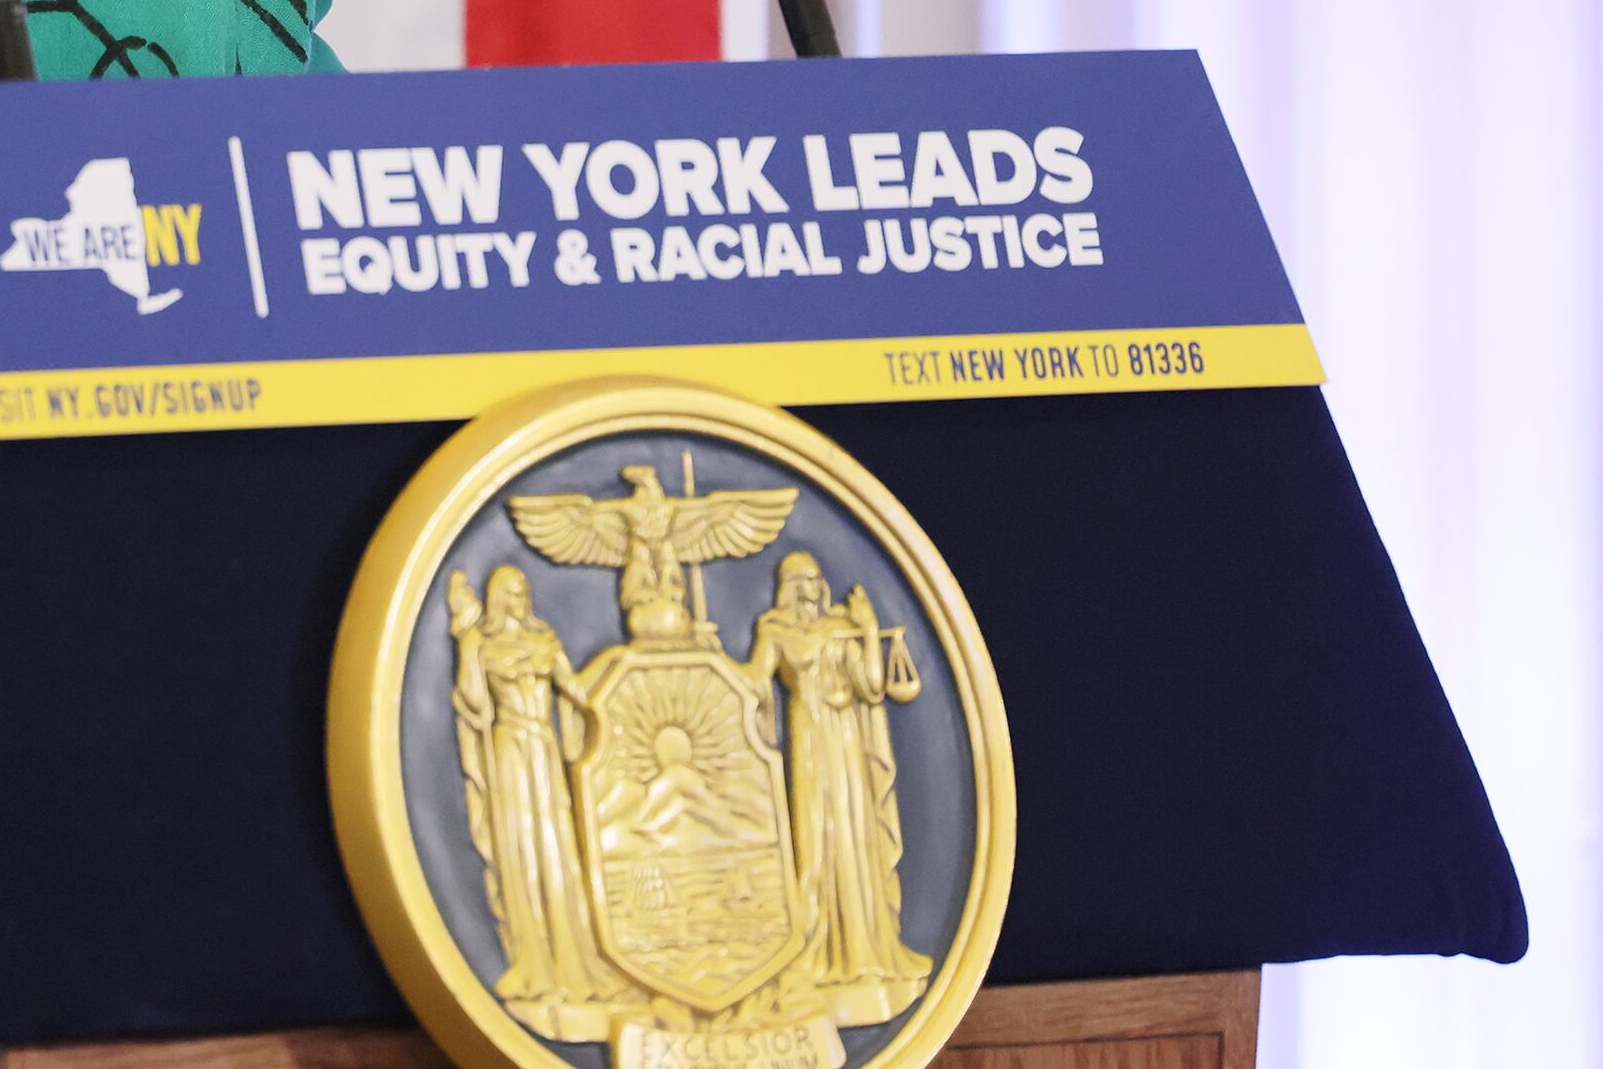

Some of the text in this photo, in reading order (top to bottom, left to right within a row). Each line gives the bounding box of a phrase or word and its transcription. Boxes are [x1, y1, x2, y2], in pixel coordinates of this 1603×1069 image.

[286, 126, 1094, 230] NEW YORK LEADS
[23, 203, 202, 267] WE ARE NY
[300, 213, 1104, 295] EQUITY & RACIAL JUSTICE
[884, 341, 1204, 385] TEXT NEW YORK TO 81336
[46, 377, 262, 420] NY.GOV/SIGNUP
[641, 1025, 814, 1065] EXCELSIOR
